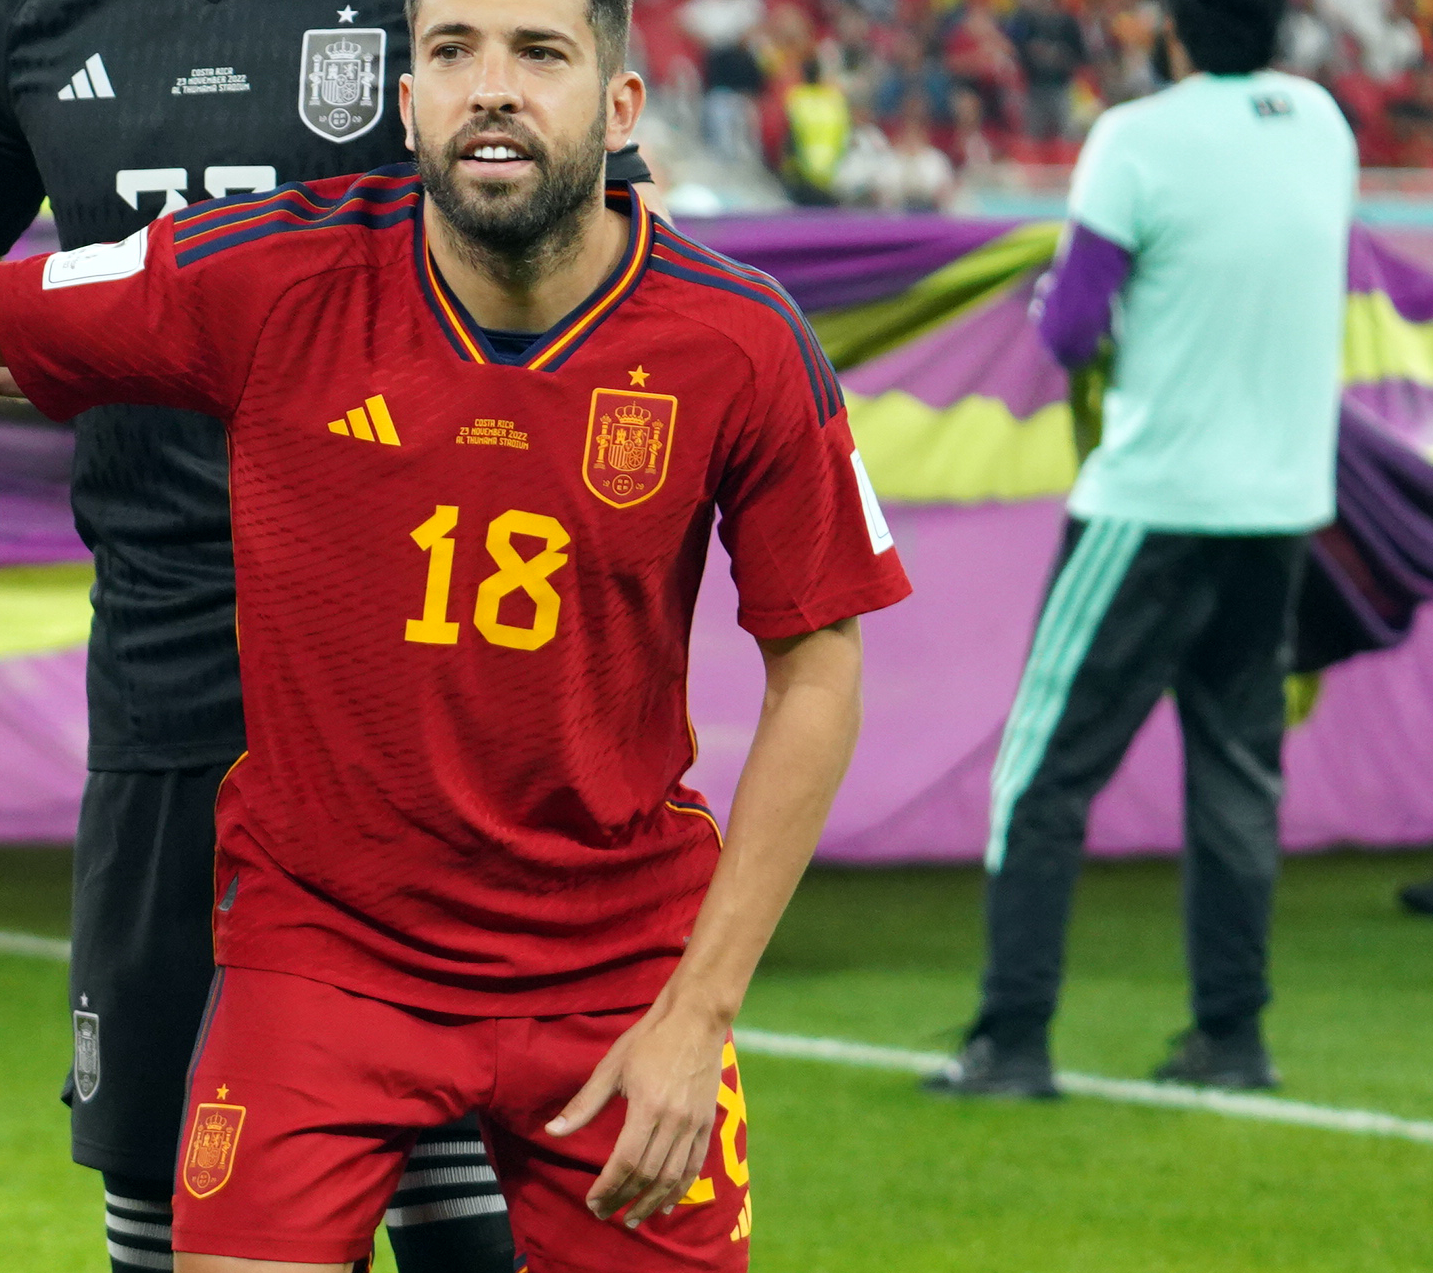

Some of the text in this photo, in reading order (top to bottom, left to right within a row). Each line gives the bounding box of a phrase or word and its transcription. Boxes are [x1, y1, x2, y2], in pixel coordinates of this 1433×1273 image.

[475, 418, 514, 429] COSTA RICA
[459, 427, 528, 441] 23 NOVEMBER 2022
[455, 436, 530, 450] AL THUMAMA STADIUM
[404, 505, 571, 651] 18
